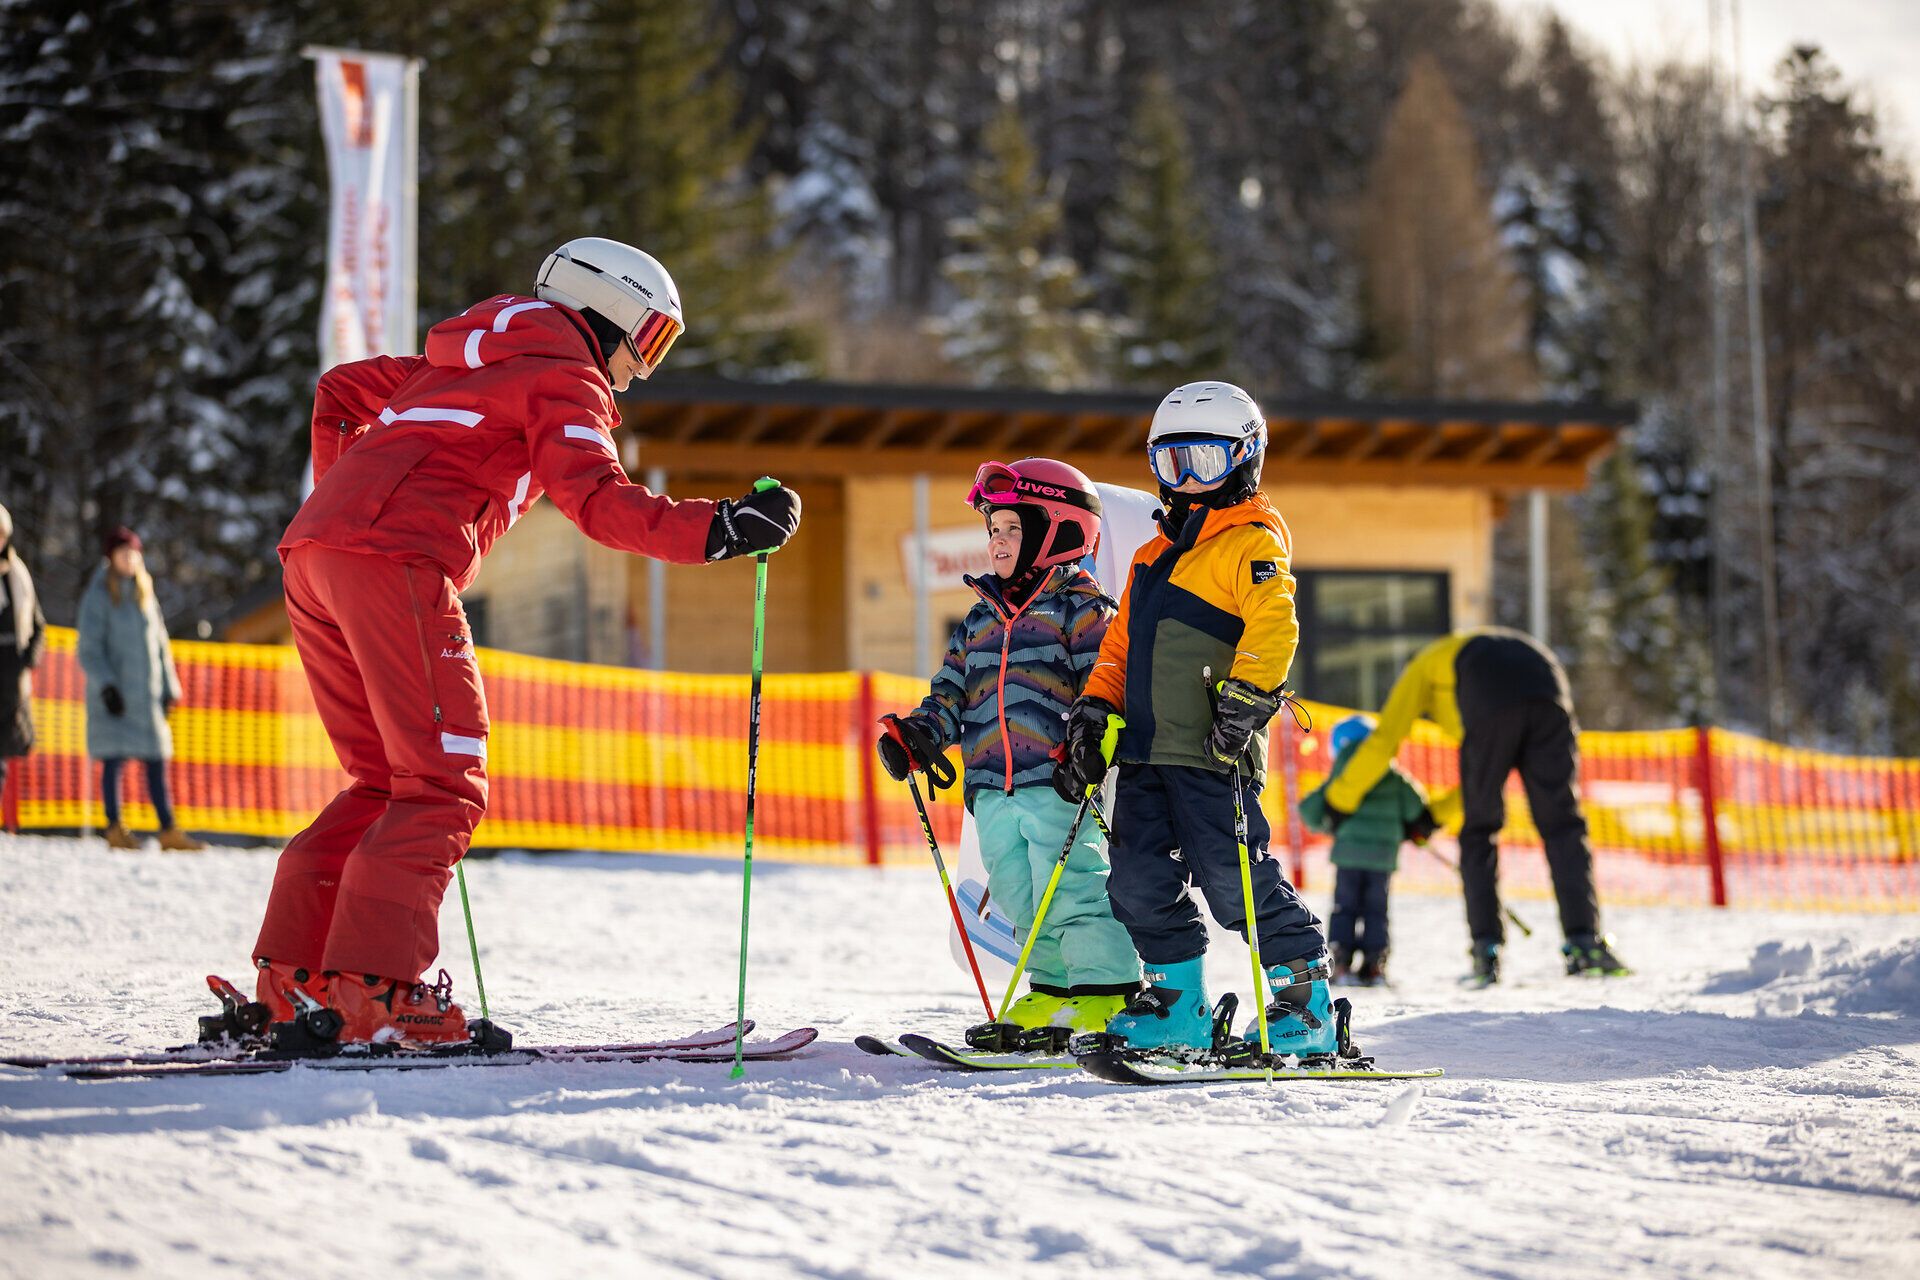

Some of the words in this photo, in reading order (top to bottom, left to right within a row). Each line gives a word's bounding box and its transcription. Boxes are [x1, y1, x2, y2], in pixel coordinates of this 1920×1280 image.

[621, 275, 653, 299] ATOMIC
[1241, 419, 1257, 433] uve
[1016, 480, 1067, 499] uvex
[1227, 690, 1256, 706] reusch
[395, 1014, 445, 1026] ATOMIC
[1276, 1029, 1309, 1039] HEAD
